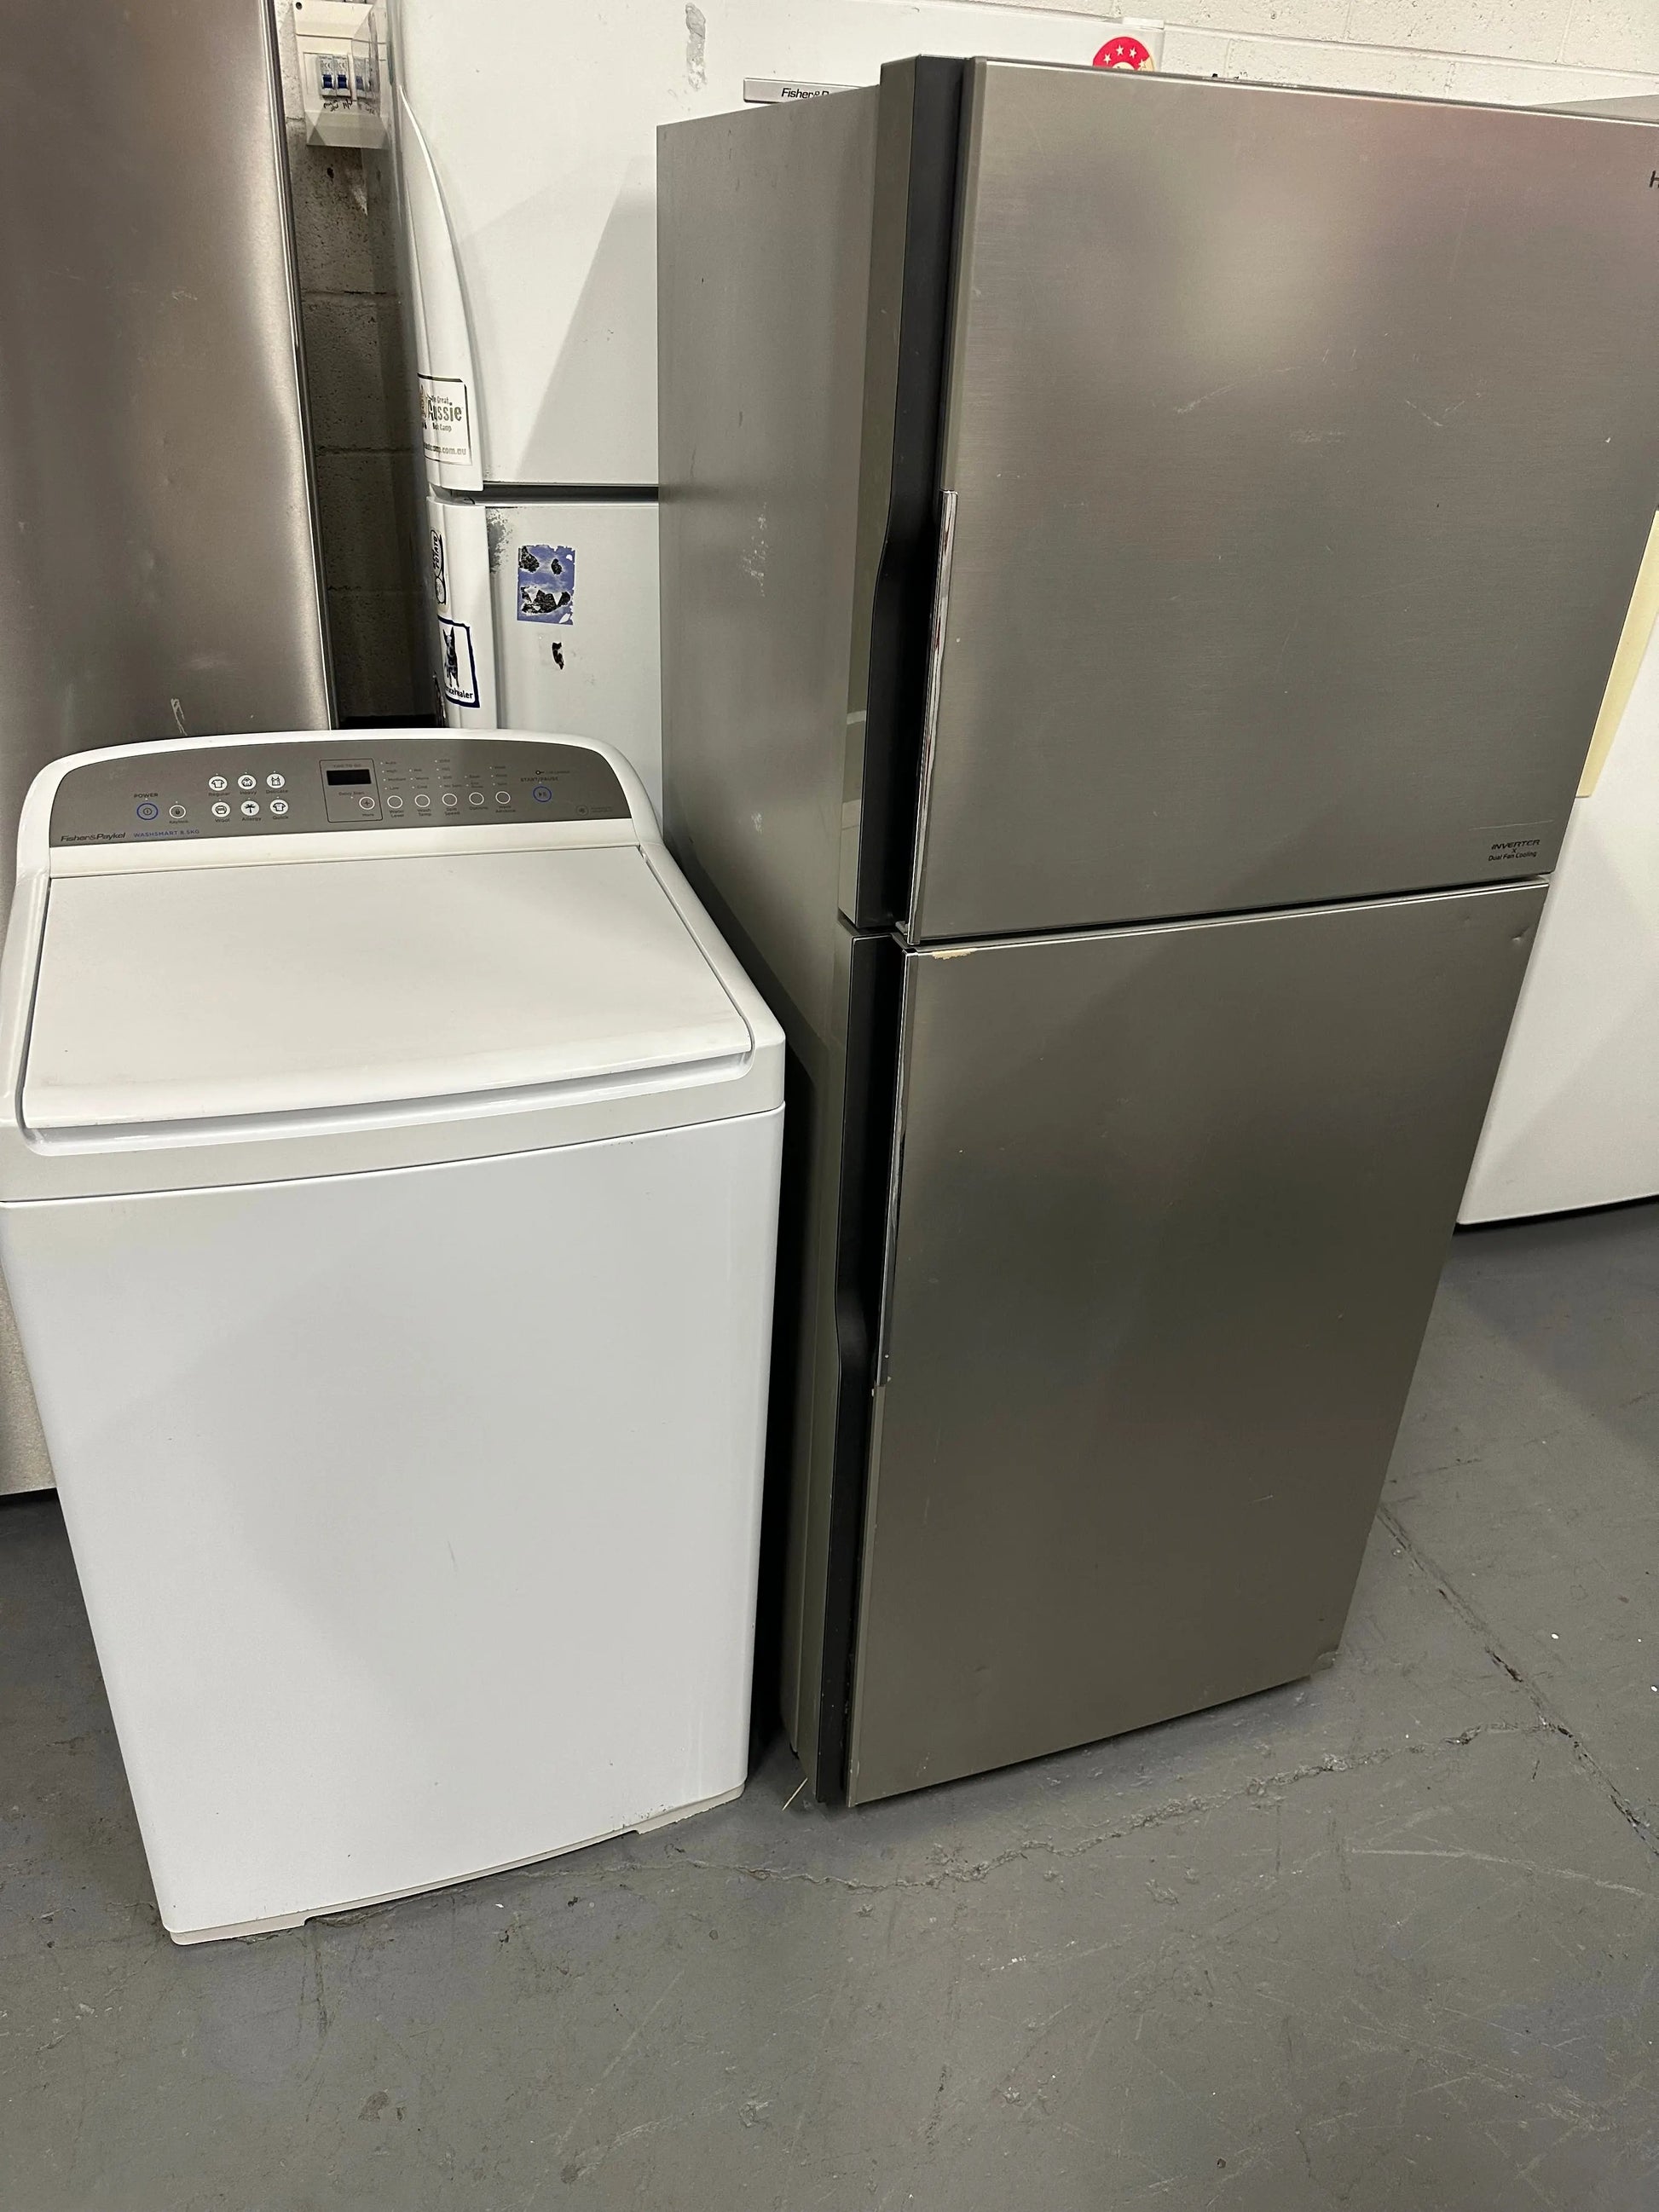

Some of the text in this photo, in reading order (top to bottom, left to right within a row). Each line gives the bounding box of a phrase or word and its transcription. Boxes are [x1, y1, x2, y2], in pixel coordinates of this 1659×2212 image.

[428, 399, 462, 422] Aussie
[133, 830, 177, 838] WASHSMART
[1491, 839, 1540, 850] INVERTER
